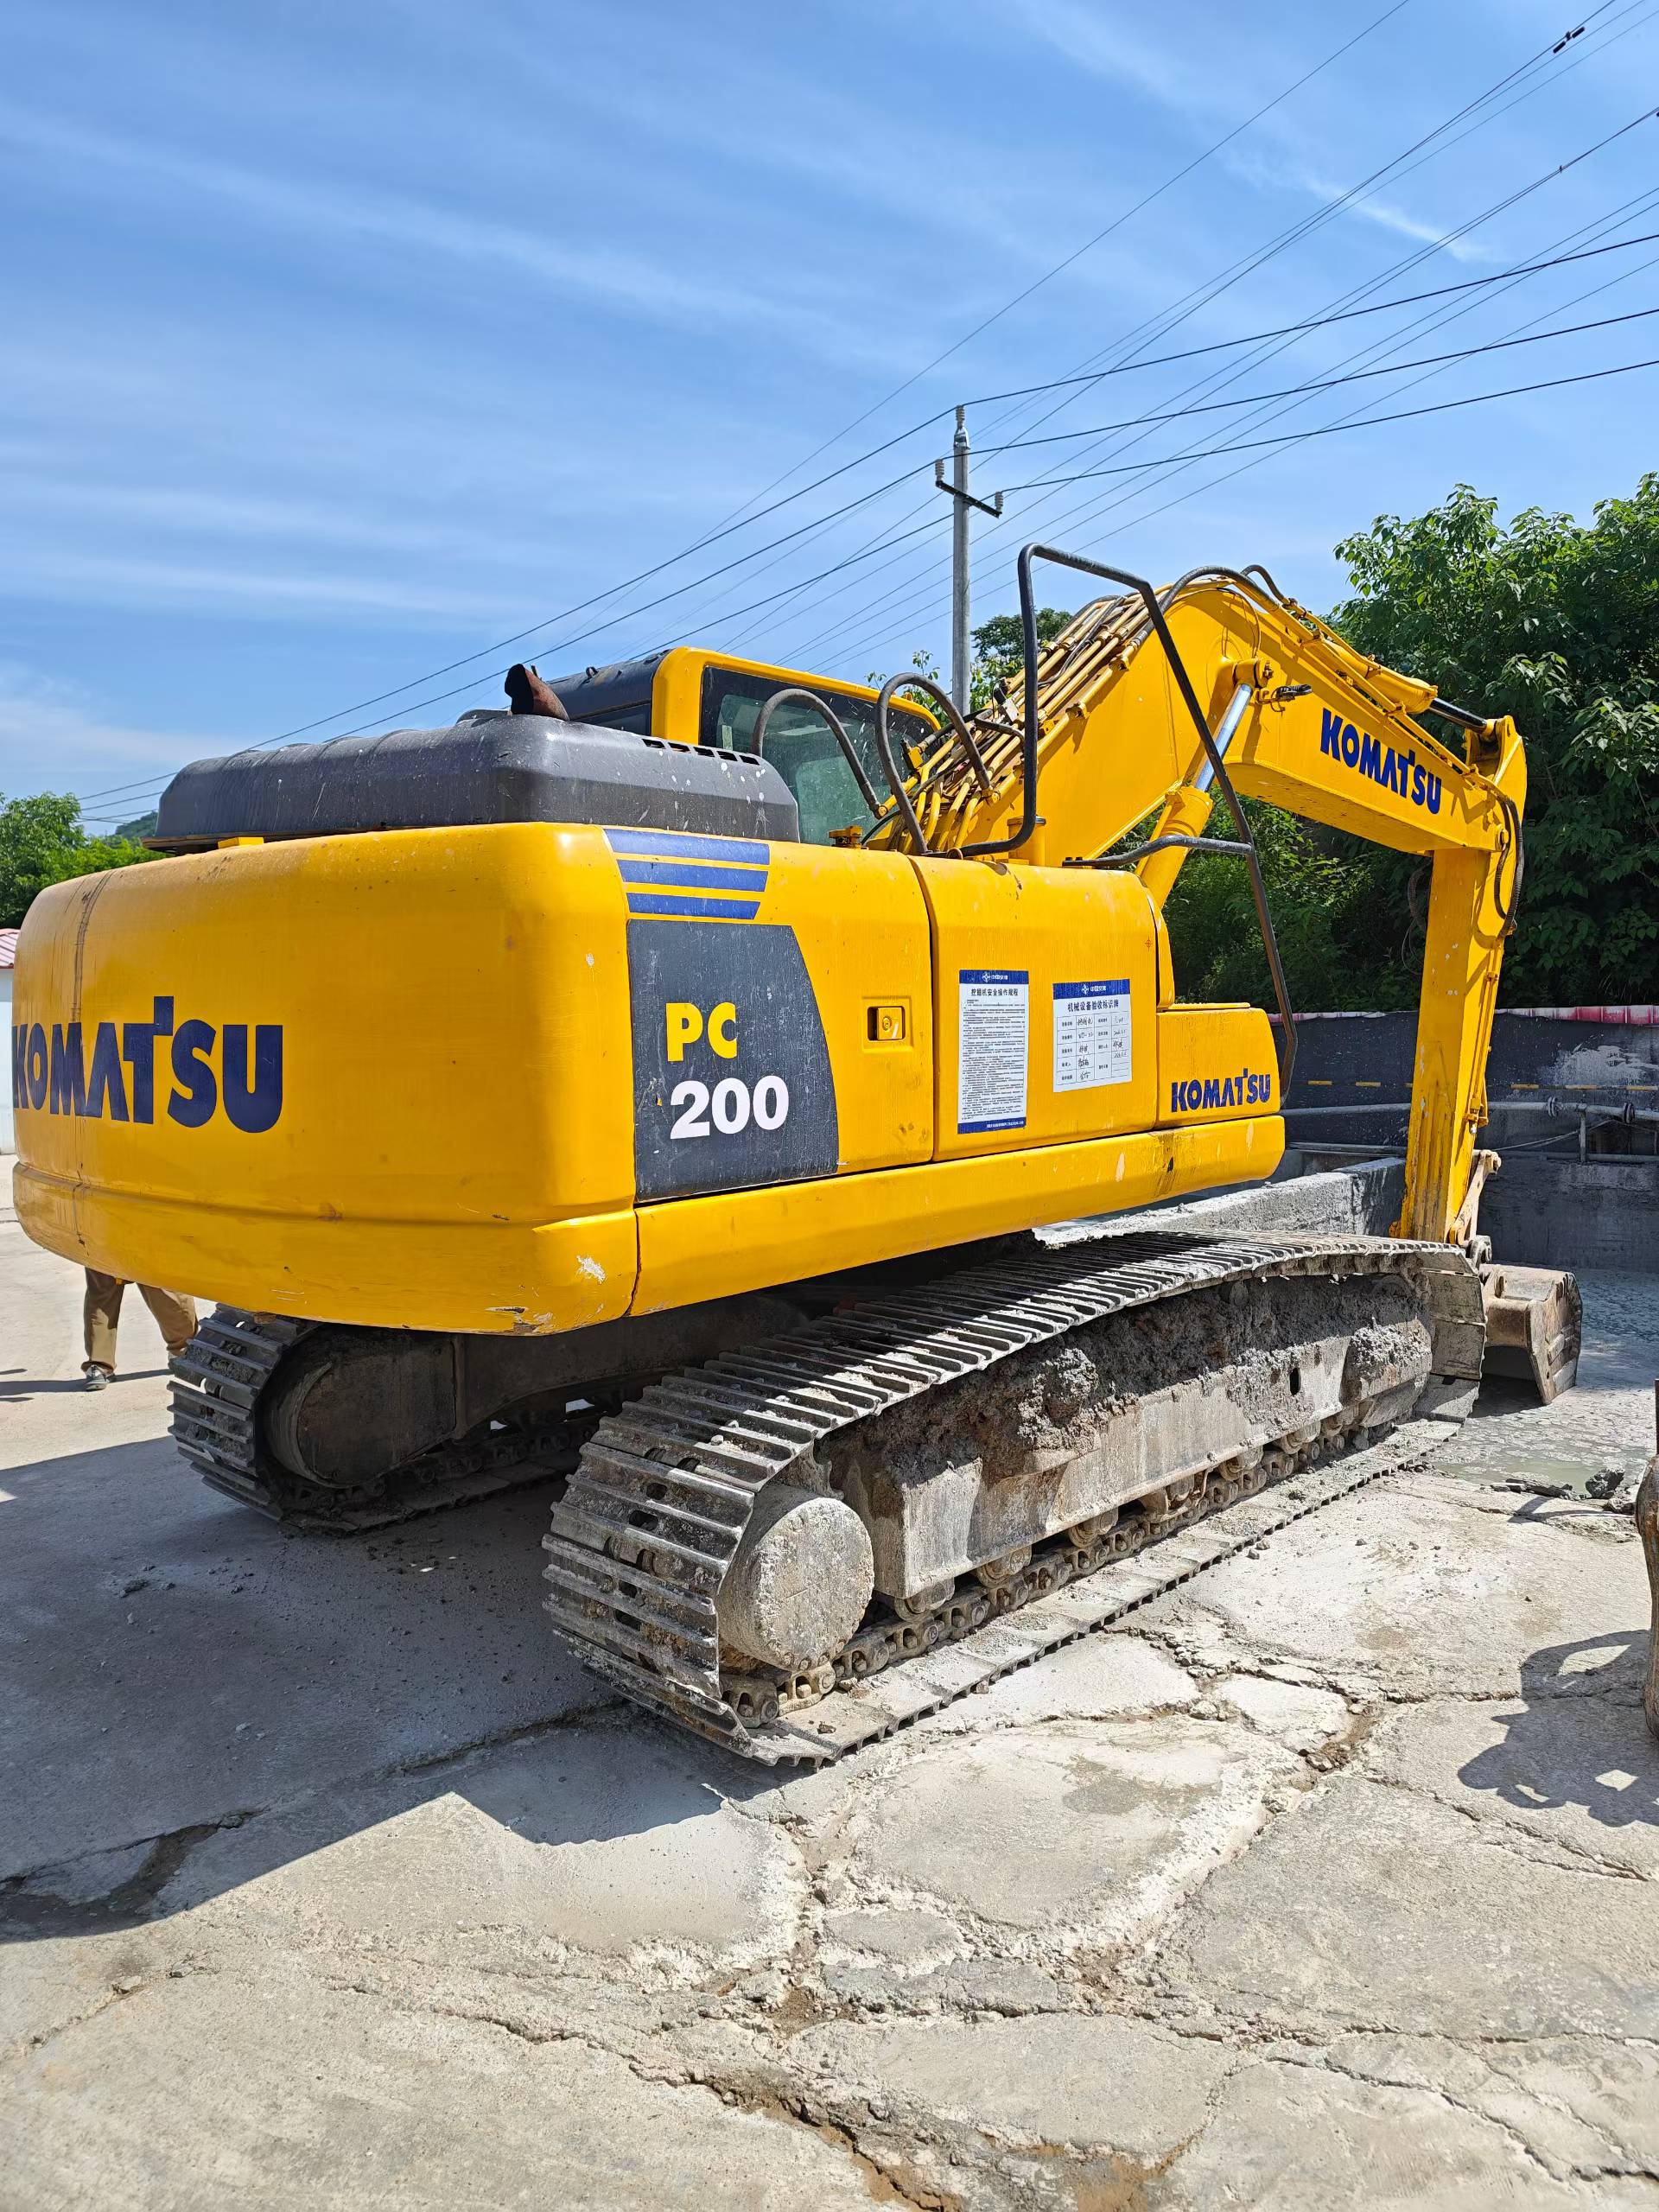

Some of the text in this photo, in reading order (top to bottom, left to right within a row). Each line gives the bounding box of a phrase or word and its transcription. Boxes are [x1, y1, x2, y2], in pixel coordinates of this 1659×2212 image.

[1320, 708, 1442, 815] KOMATSU
[665, 1001, 737, 1062] PC
[1067, 999, 1119, 1012] 机械设备验收标识牌
[11, 995, 283, 1133] KOMATSU
[1171, 1068, 1271, 1113] KOMATSU
[670, 1075, 790, 1140] 200
